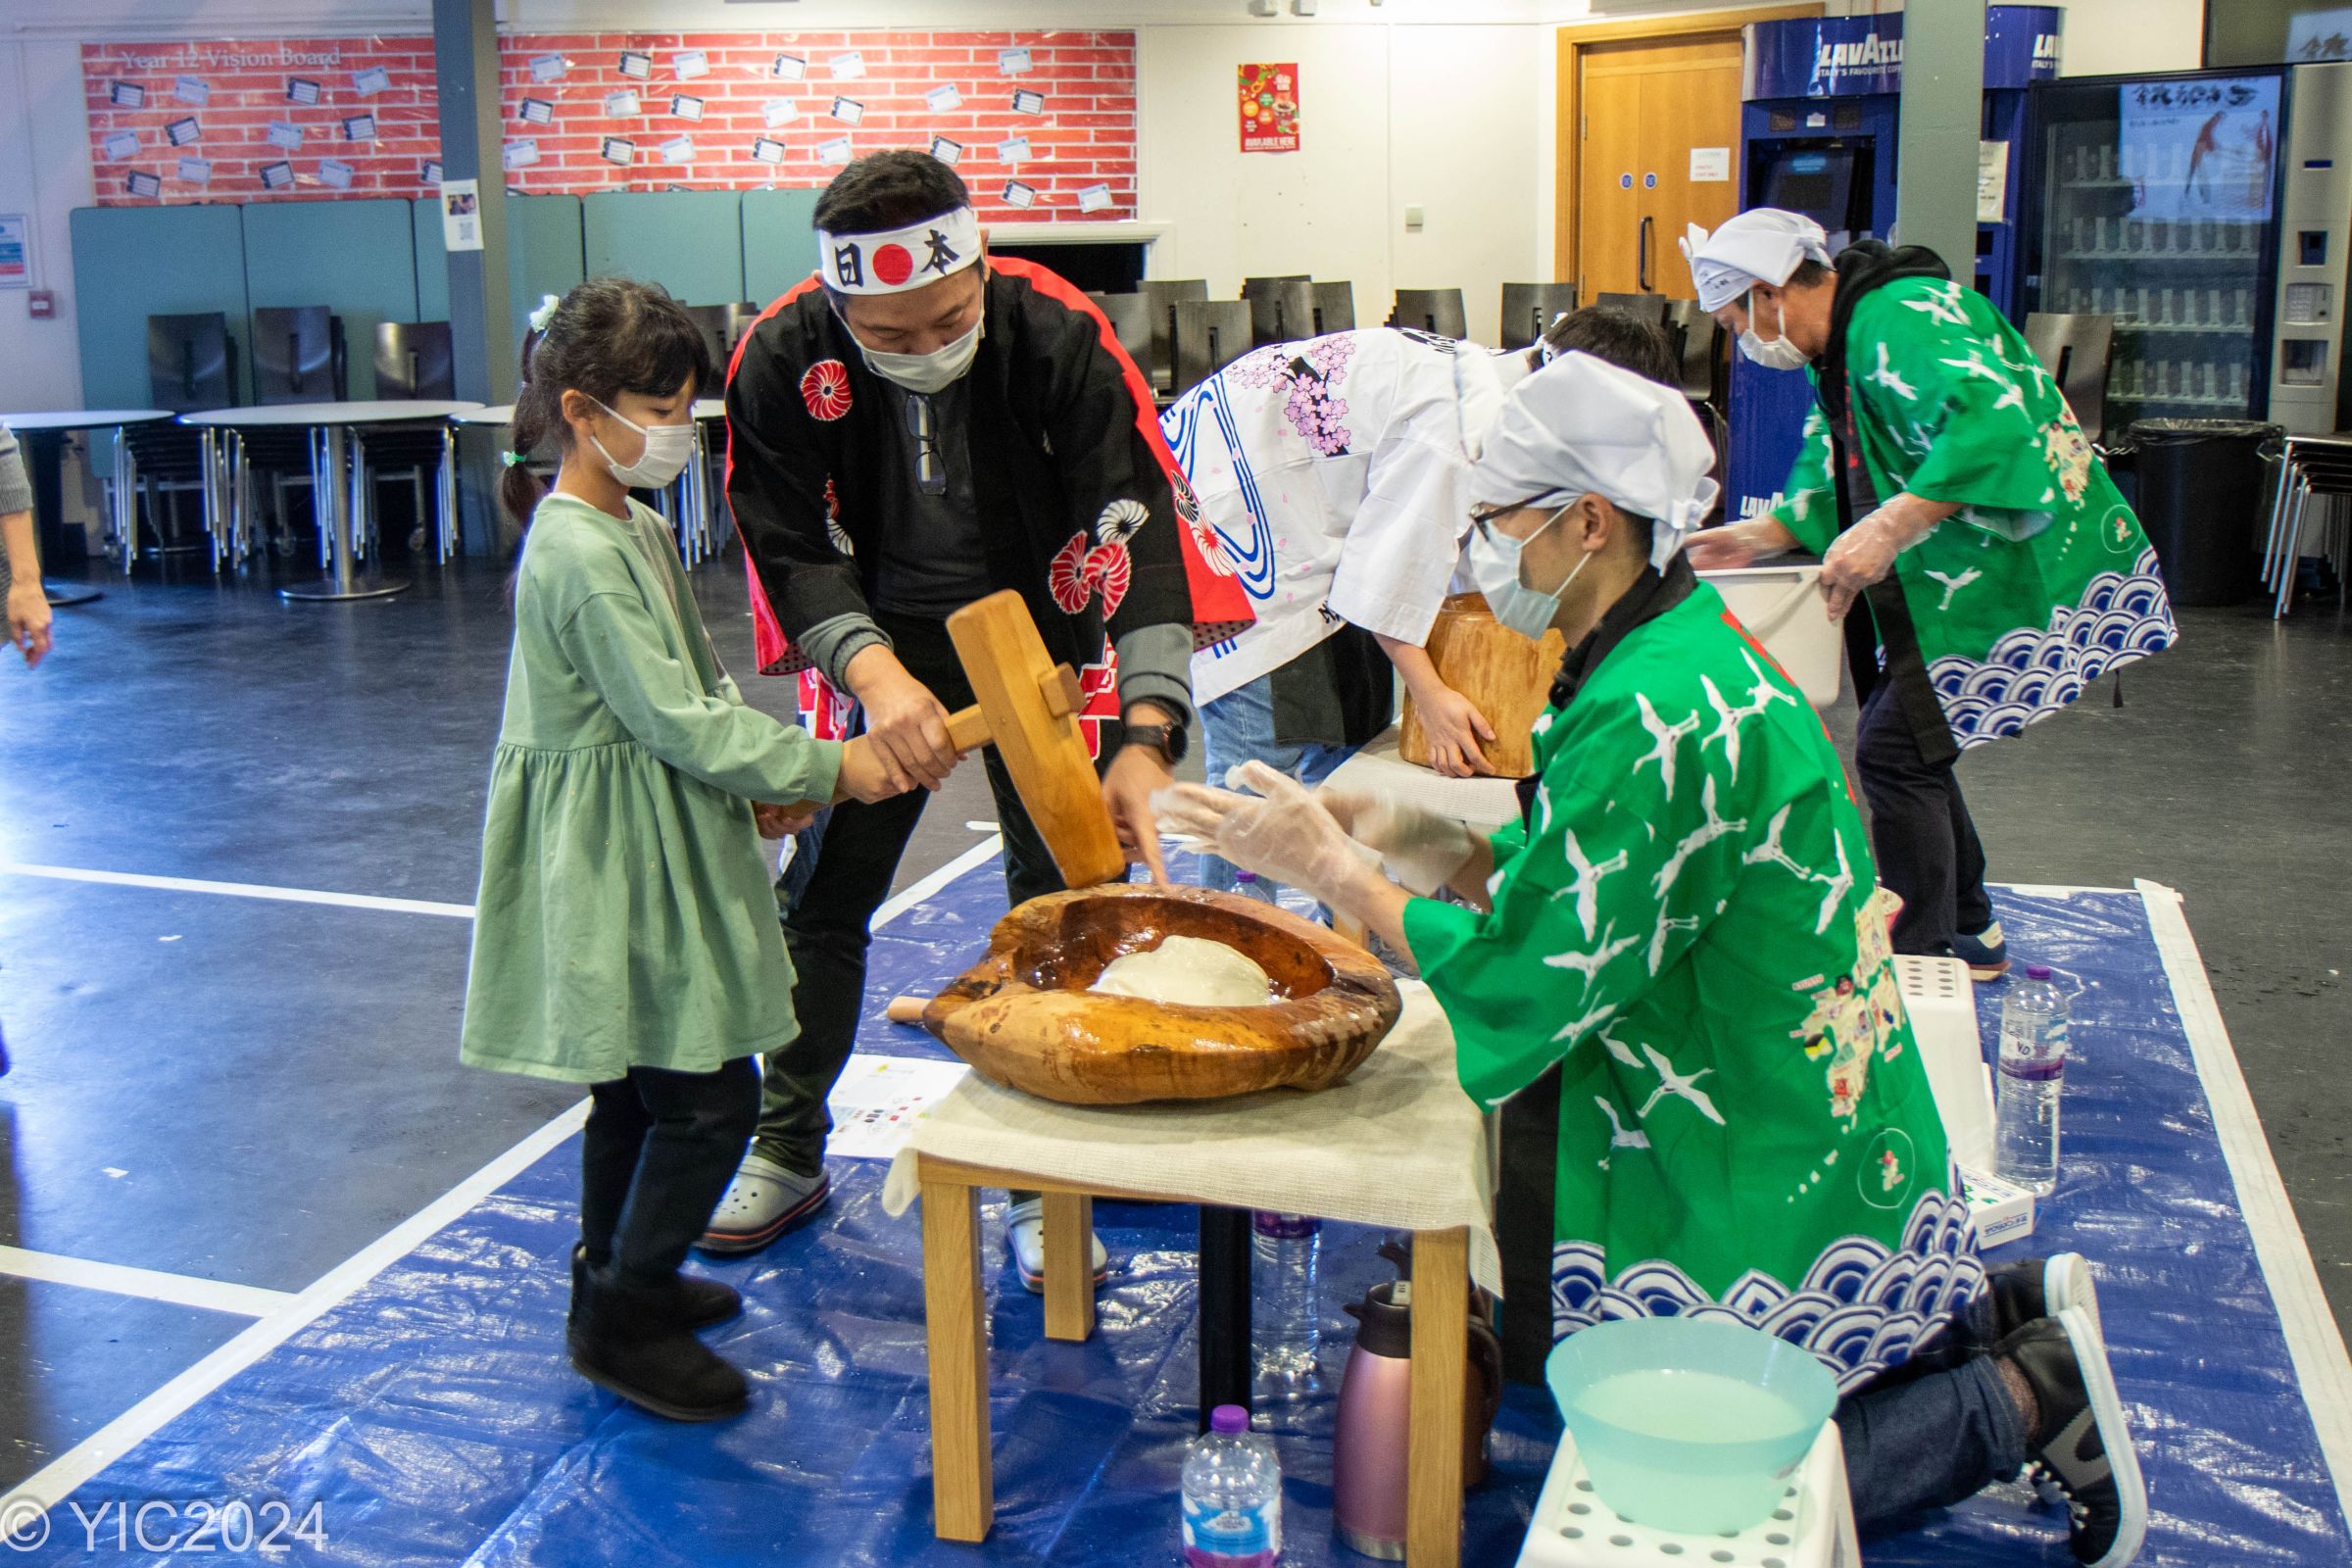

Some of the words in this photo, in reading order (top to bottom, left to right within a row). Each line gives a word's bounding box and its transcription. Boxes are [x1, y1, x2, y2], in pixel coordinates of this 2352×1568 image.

[122, 51, 169, 70] Year
[176, 50, 199, 68] 12
[206, 49, 273, 68] Vision
[279, 47, 342, 66] Board
[1819, 33, 1903, 68] LAVAZZ
[834, 228, 961, 288] 日本
